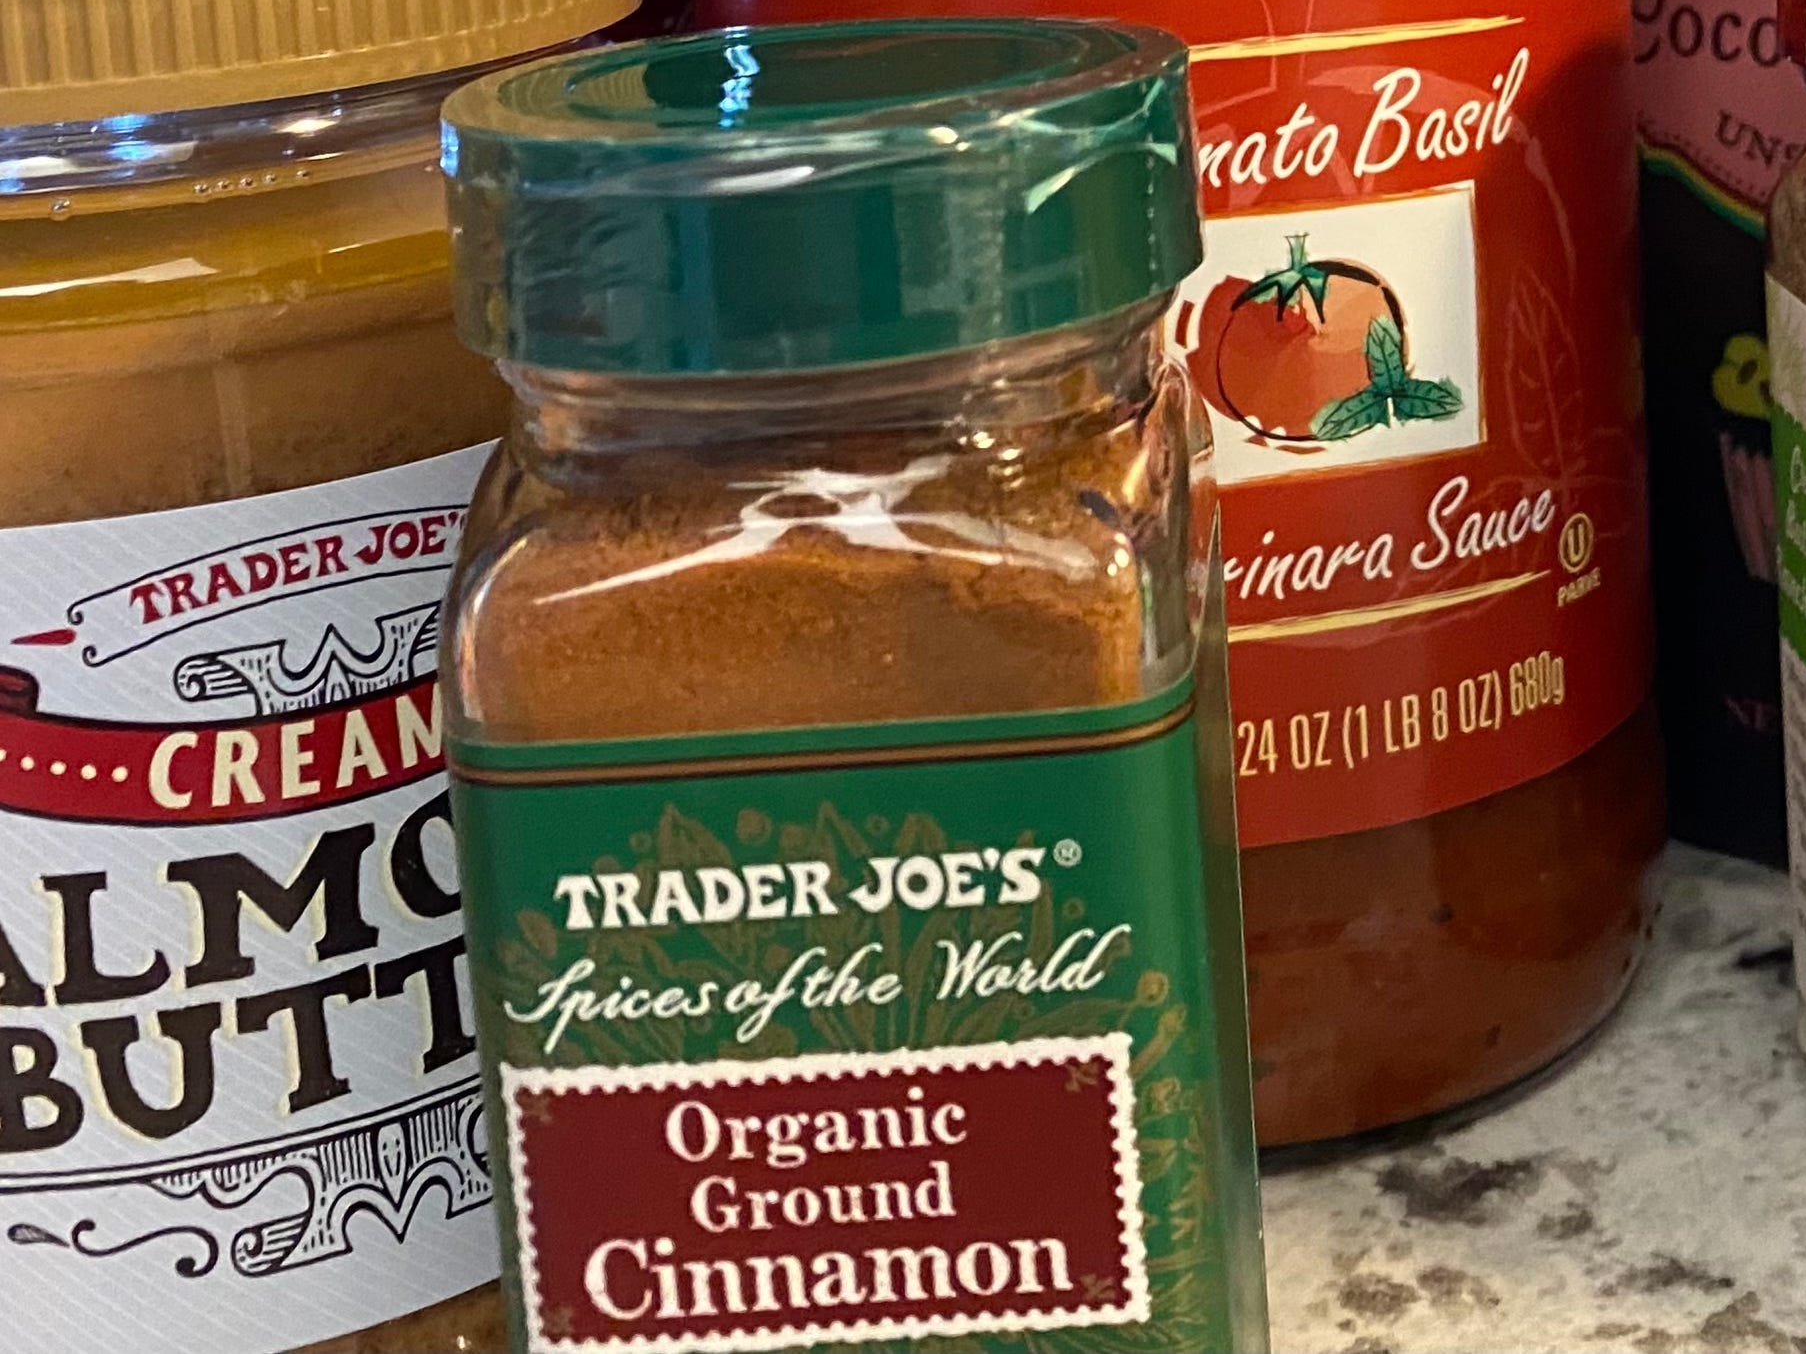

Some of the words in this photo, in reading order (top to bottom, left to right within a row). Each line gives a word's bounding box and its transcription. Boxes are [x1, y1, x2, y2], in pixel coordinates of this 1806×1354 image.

[1354, 47, 1530, 177] Basil
[129, 535, 345, 625] TRADER
[354, 511, 467, 565] JOE'
[1411, 475, 1555, 571] Sauce
[1237, 719, 1277, 777] 24
[1290, 710, 1332, 770] OZ
[1342, 703, 1370, 769] (1
[1383, 693, 1421, 754] LB
[1431, 686, 1448, 742] 8
[1459, 670, 1502, 730] OZ)
[1509, 649, 1566, 718] 680g
[553, 859, 838, 931] TRADER
[504, 952, 720, 1055] Spices
[724, 946, 822, 1045] of
[799, 944, 902, 1009] the
[933, 924, 1132, 1004] World
[665, 1087, 968, 1168] Organic
[690, 1161, 957, 1233] Ground
[583, 1234, 1074, 1323] Cinnamon
